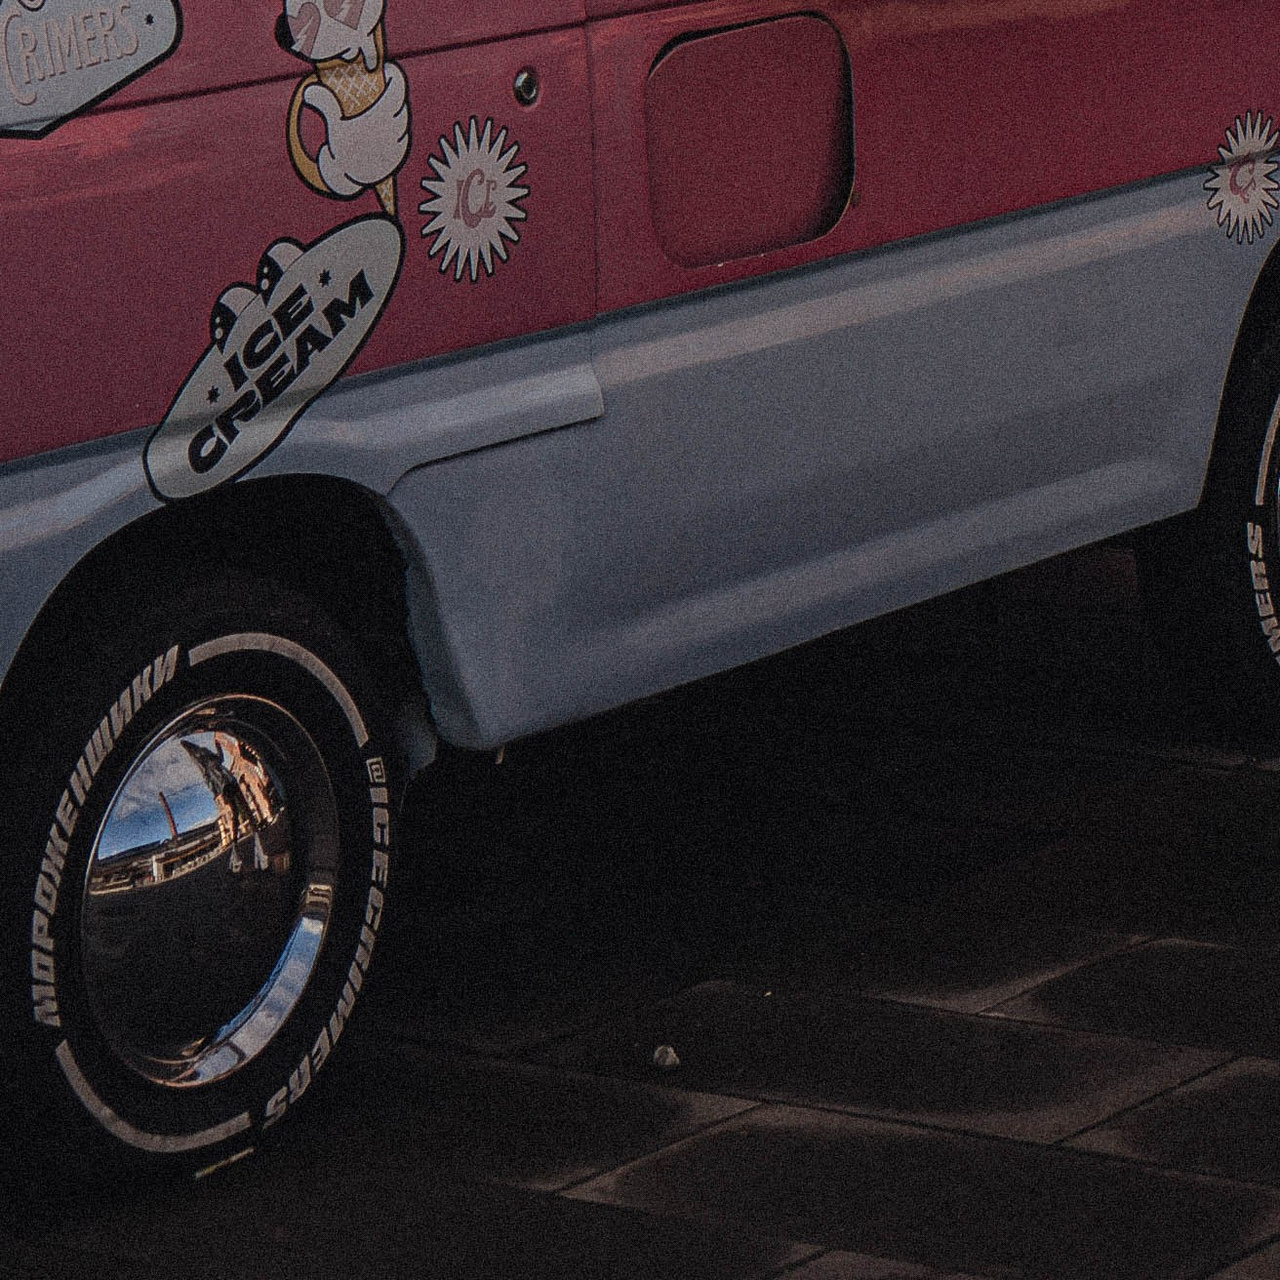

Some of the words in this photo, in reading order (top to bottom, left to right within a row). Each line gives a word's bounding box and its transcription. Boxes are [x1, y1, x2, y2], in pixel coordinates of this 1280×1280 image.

[186, 269, 376, 476] CREAM
[223, 281, 316, 393] ICE
[31, 644, 181, 1028] МОРОЖЕНЩИКИ
